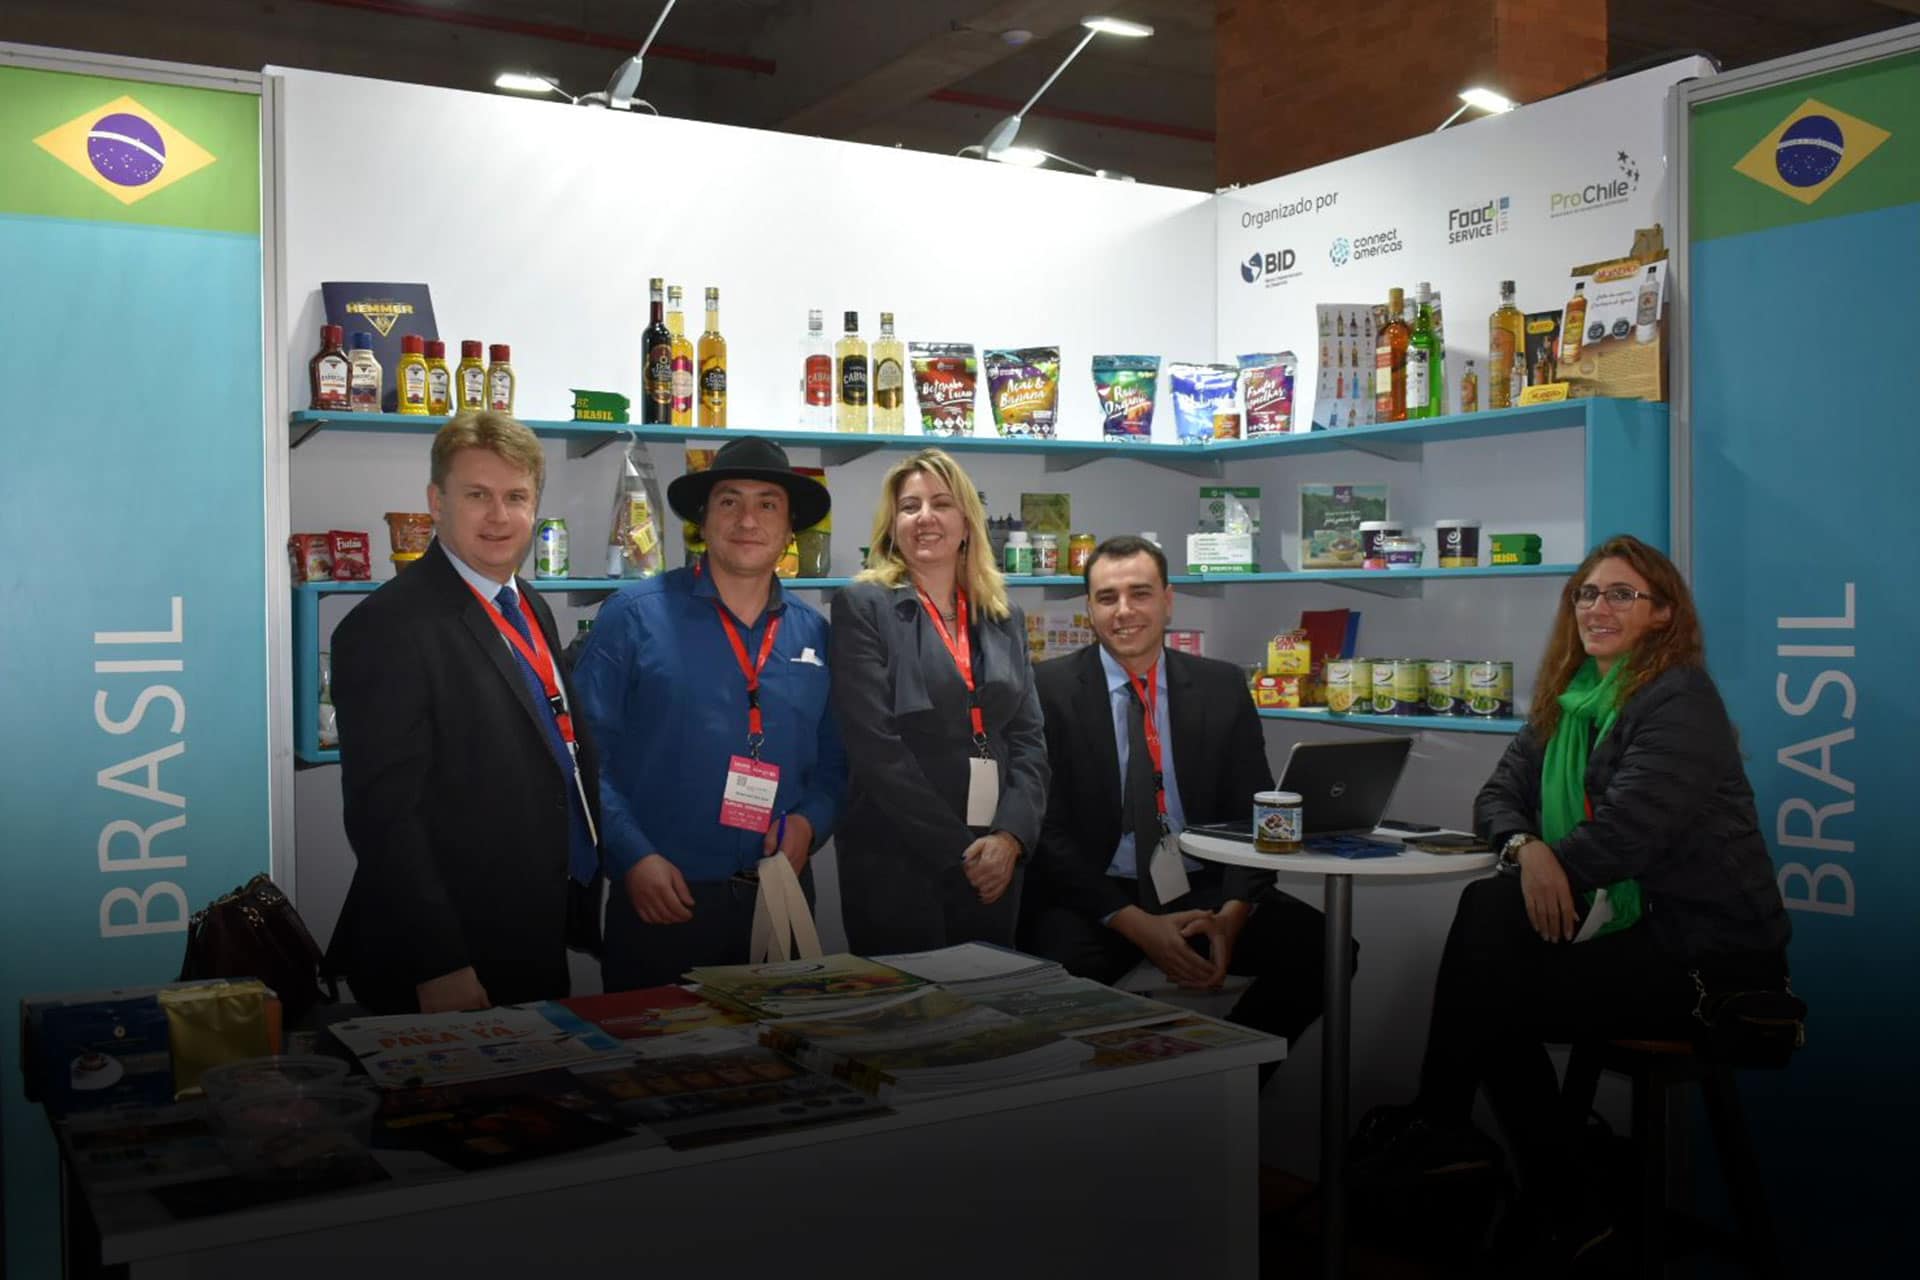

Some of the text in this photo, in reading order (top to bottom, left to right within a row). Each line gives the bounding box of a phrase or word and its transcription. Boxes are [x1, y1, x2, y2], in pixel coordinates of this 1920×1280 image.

[1551, 179, 1629, 211] ProChile
[1241, 192, 1339, 229] Organizado por
[1449, 200, 1495, 231] Food
[1353, 228, 1398, 249] connect
[1449, 224, 1493, 245] SERVICE
[1265, 248, 1296, 275] BID
[1353, 240, 1403, 260] americas
[345, 302, 414, 314] HEMMER
[1776, 582, 1857, 917] BRASIL
[94, 596, 190, 939] BRASIL
